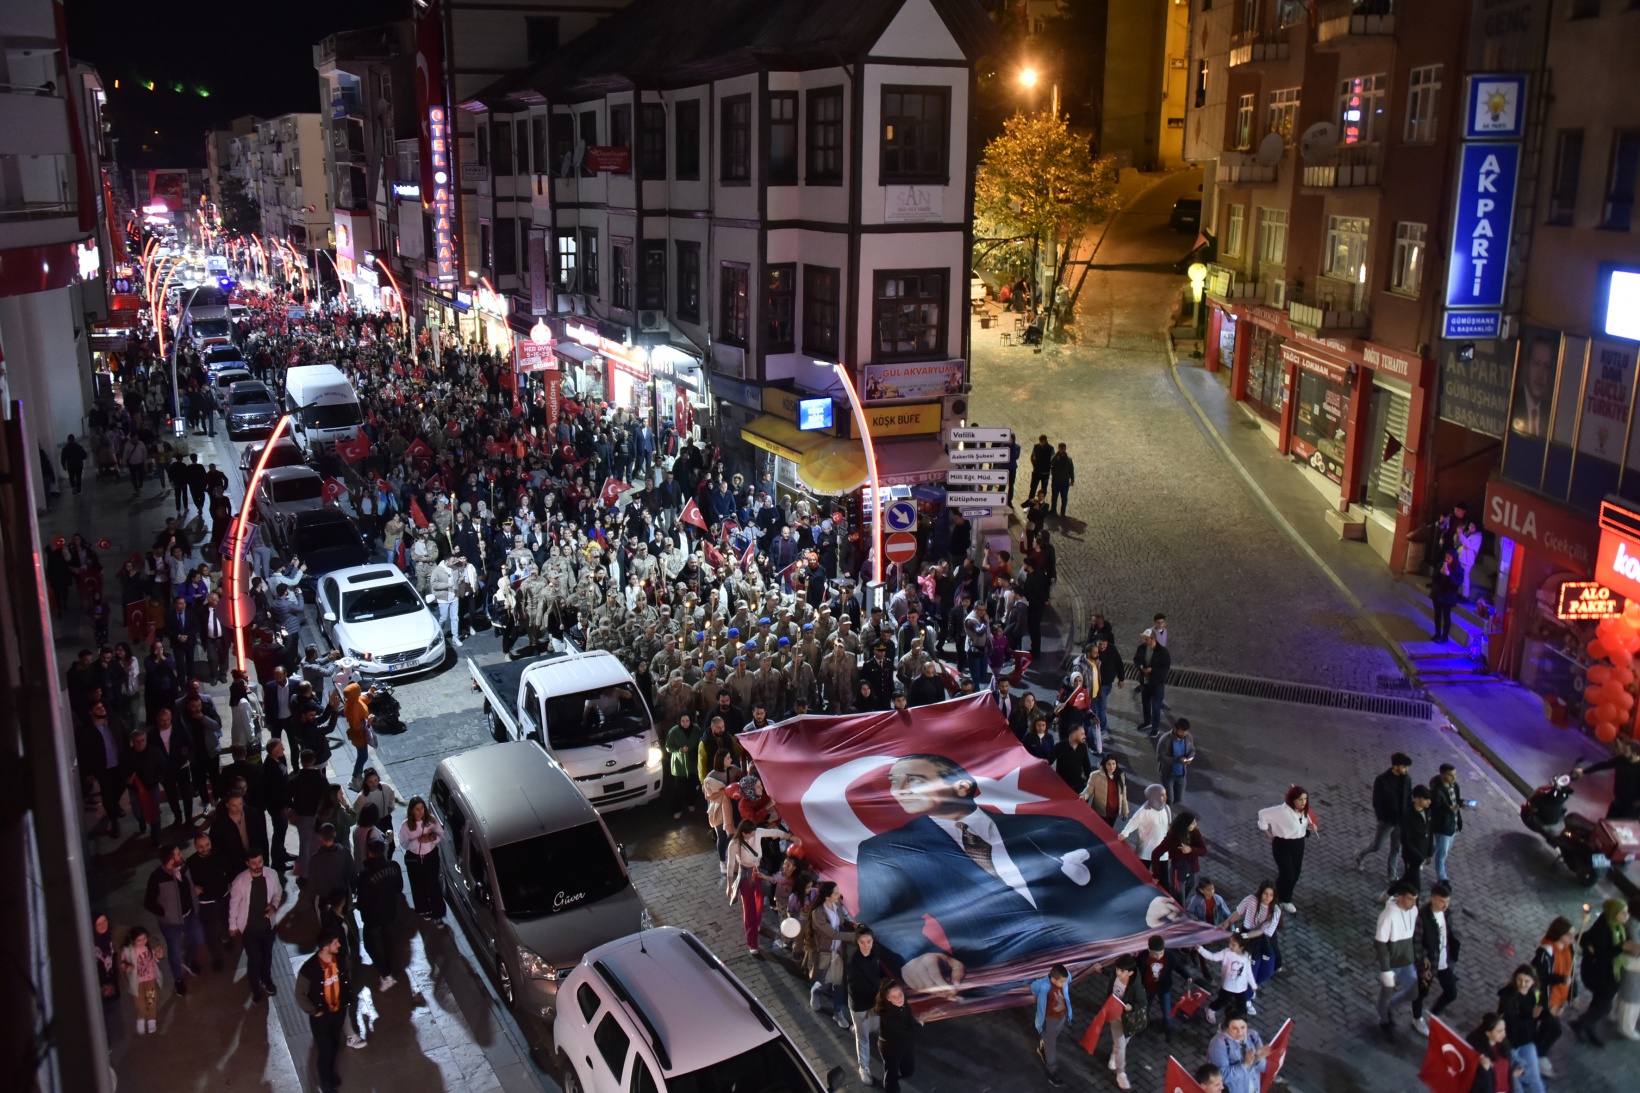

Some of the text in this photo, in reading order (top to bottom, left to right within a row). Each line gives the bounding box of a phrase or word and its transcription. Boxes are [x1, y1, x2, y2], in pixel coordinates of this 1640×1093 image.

[431, 109, 445, 167] OTEL
[436, 188, 451, 273] ATALAY
[1472, 154, 1501, 296] AK PARTİ
[1451, 316, 1495, 325] GÜMÜŞHANE
[903, 365, 952, 376] AKVARYUM
[1302, 358, 1329, 376] LOKMAN
[1446, 379, 1509, 411] GÜMÜŞHAN
[872, 412, 920, 428] KÖŞK BÜFE
[949, 495, 988, 503] Kütüphane
[1490, 496, 1588, 563] SILA Çiçekçilik
[1579, 587, 1610, 600] ALO
[1568, 600, 1617, 613] PAKET
